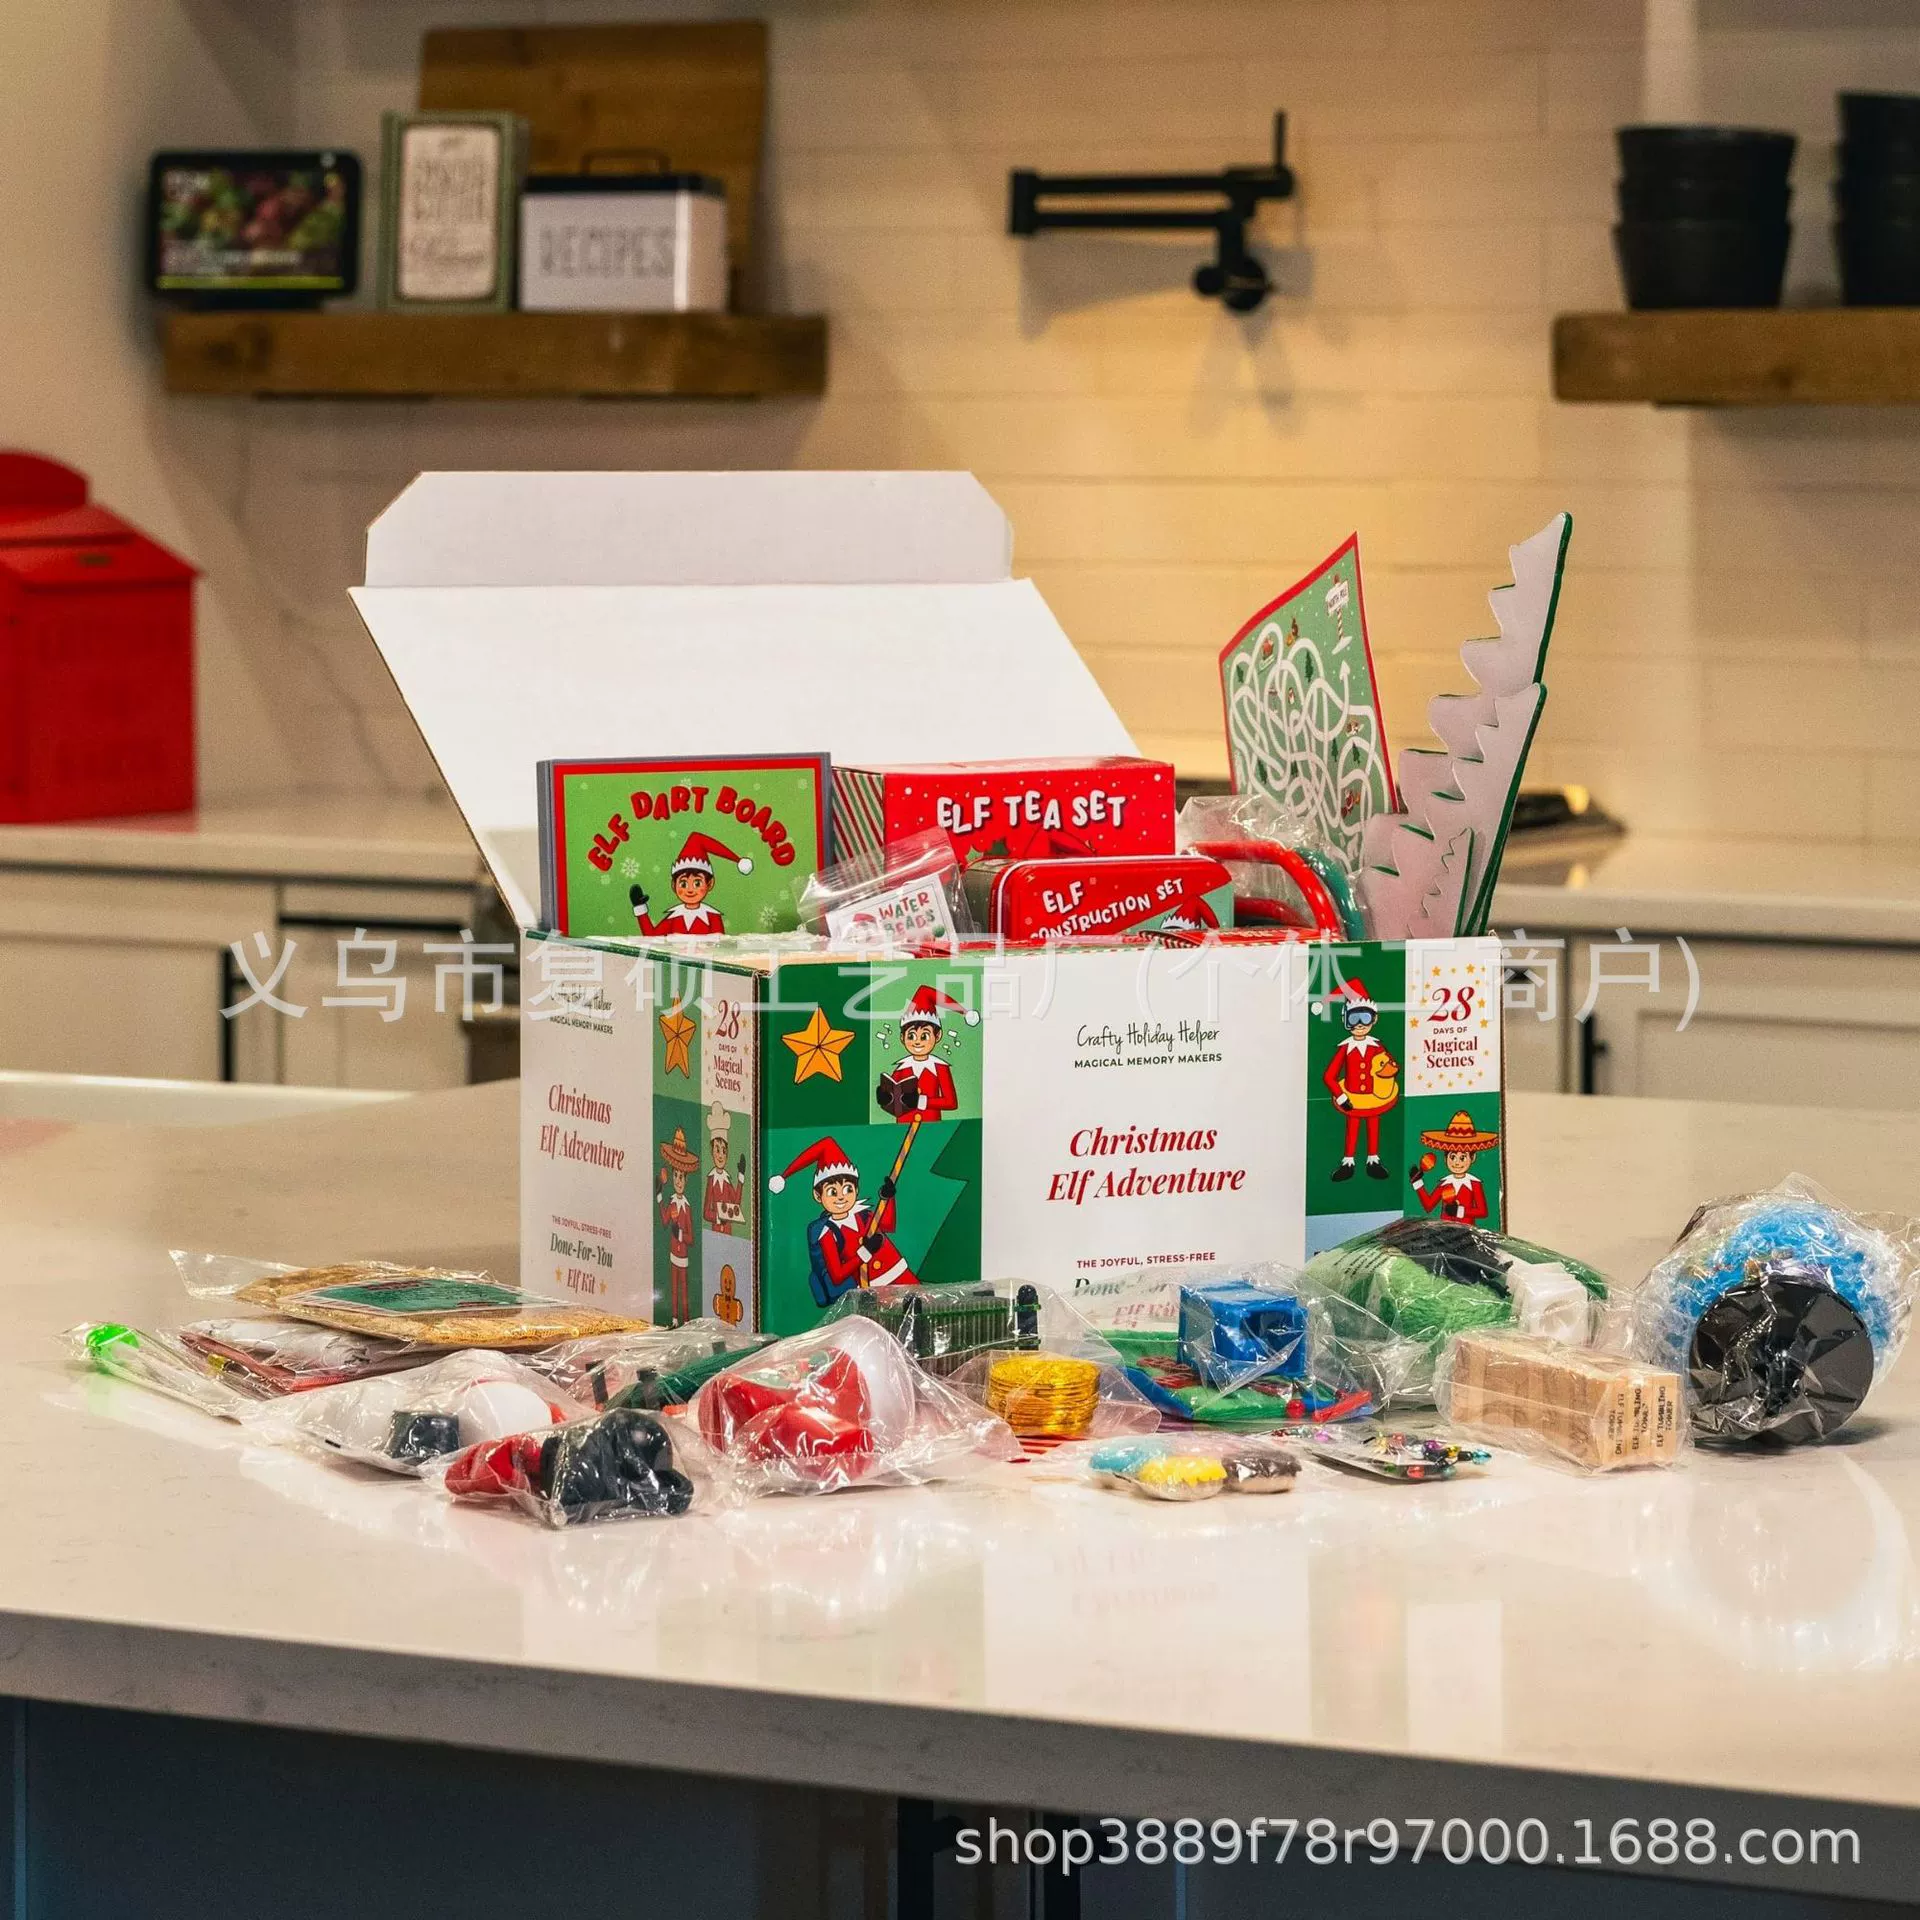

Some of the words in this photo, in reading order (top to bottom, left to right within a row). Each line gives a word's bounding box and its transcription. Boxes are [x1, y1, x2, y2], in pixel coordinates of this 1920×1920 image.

[937, 796, 992, 834] ELF
[1003, 790, 1061, 829] TEA
[1072, 790, 1126, 827] SET
[588, 814, 630, 872] ELF
[631, 786, 709, 820] DART
[716, 786, 796, 866] BOARD
[1042, 880, 1084, 913] ELF
[1156, 878, 1184, 900] SET
[879, 892, 930, 920] WATER
[883, 909, 936, 937] BEADS
[716, 999, 740, 1039] 28
[1427, 986, 1475, 1022] 28
[571, 1018, 592, 1030] MEMORY
[593, 1023, 614, 1035] MAKERS
[1077, 1024, 1123, 1055] Crafty
[1126, 1022, 1175, 1052] Holiday
[1178, 1019, 1220, 1051] Helper
[1433, 1027, 1454, 1035] DAYS
[1456, 1026, 1468, 1034] OF
[1423, 1036, 1478, 1055] Magical
[713, 1054, 743, 1076] Magical
[1074, 1058, 1123, 1069] MAGICAL
[1127, 1055, 1174, 1066] MEMORY
[1178, 1053, 1222, 1064] MAKERS
[1426, 1054, 1475, 1069] Scenes
[715, 1072, 741, 1093] Scenes
[549, 1084, 612, 1125] Christmas
[540, 1124, 560, 1160] Elf
[559, 1130, 625, 1171] Adventure
[1070, 1125, 1217, 1157] Christmas
[1046, 1169, 1095, 1205] Elf
[1094, 1167, 1246, 1199] Adventure
[550, 1232, 613, 1268] Done-For-You
[1077, 1259, 1097, 1268] THE
[1100, 1256, 1143, 1267] JOYFUL,
[1147, 1252, 1216, 1264] STRESS-FREE
[567, 1268, 582, 1294] Elf
[581, 1272, 596, 1295] Kit
[1657, 1386, 1666, 1430] TUMBLING
[1615, 1411, 1624, 1455] TUMING
[1656, 1433, 1664, 1448] ELF
